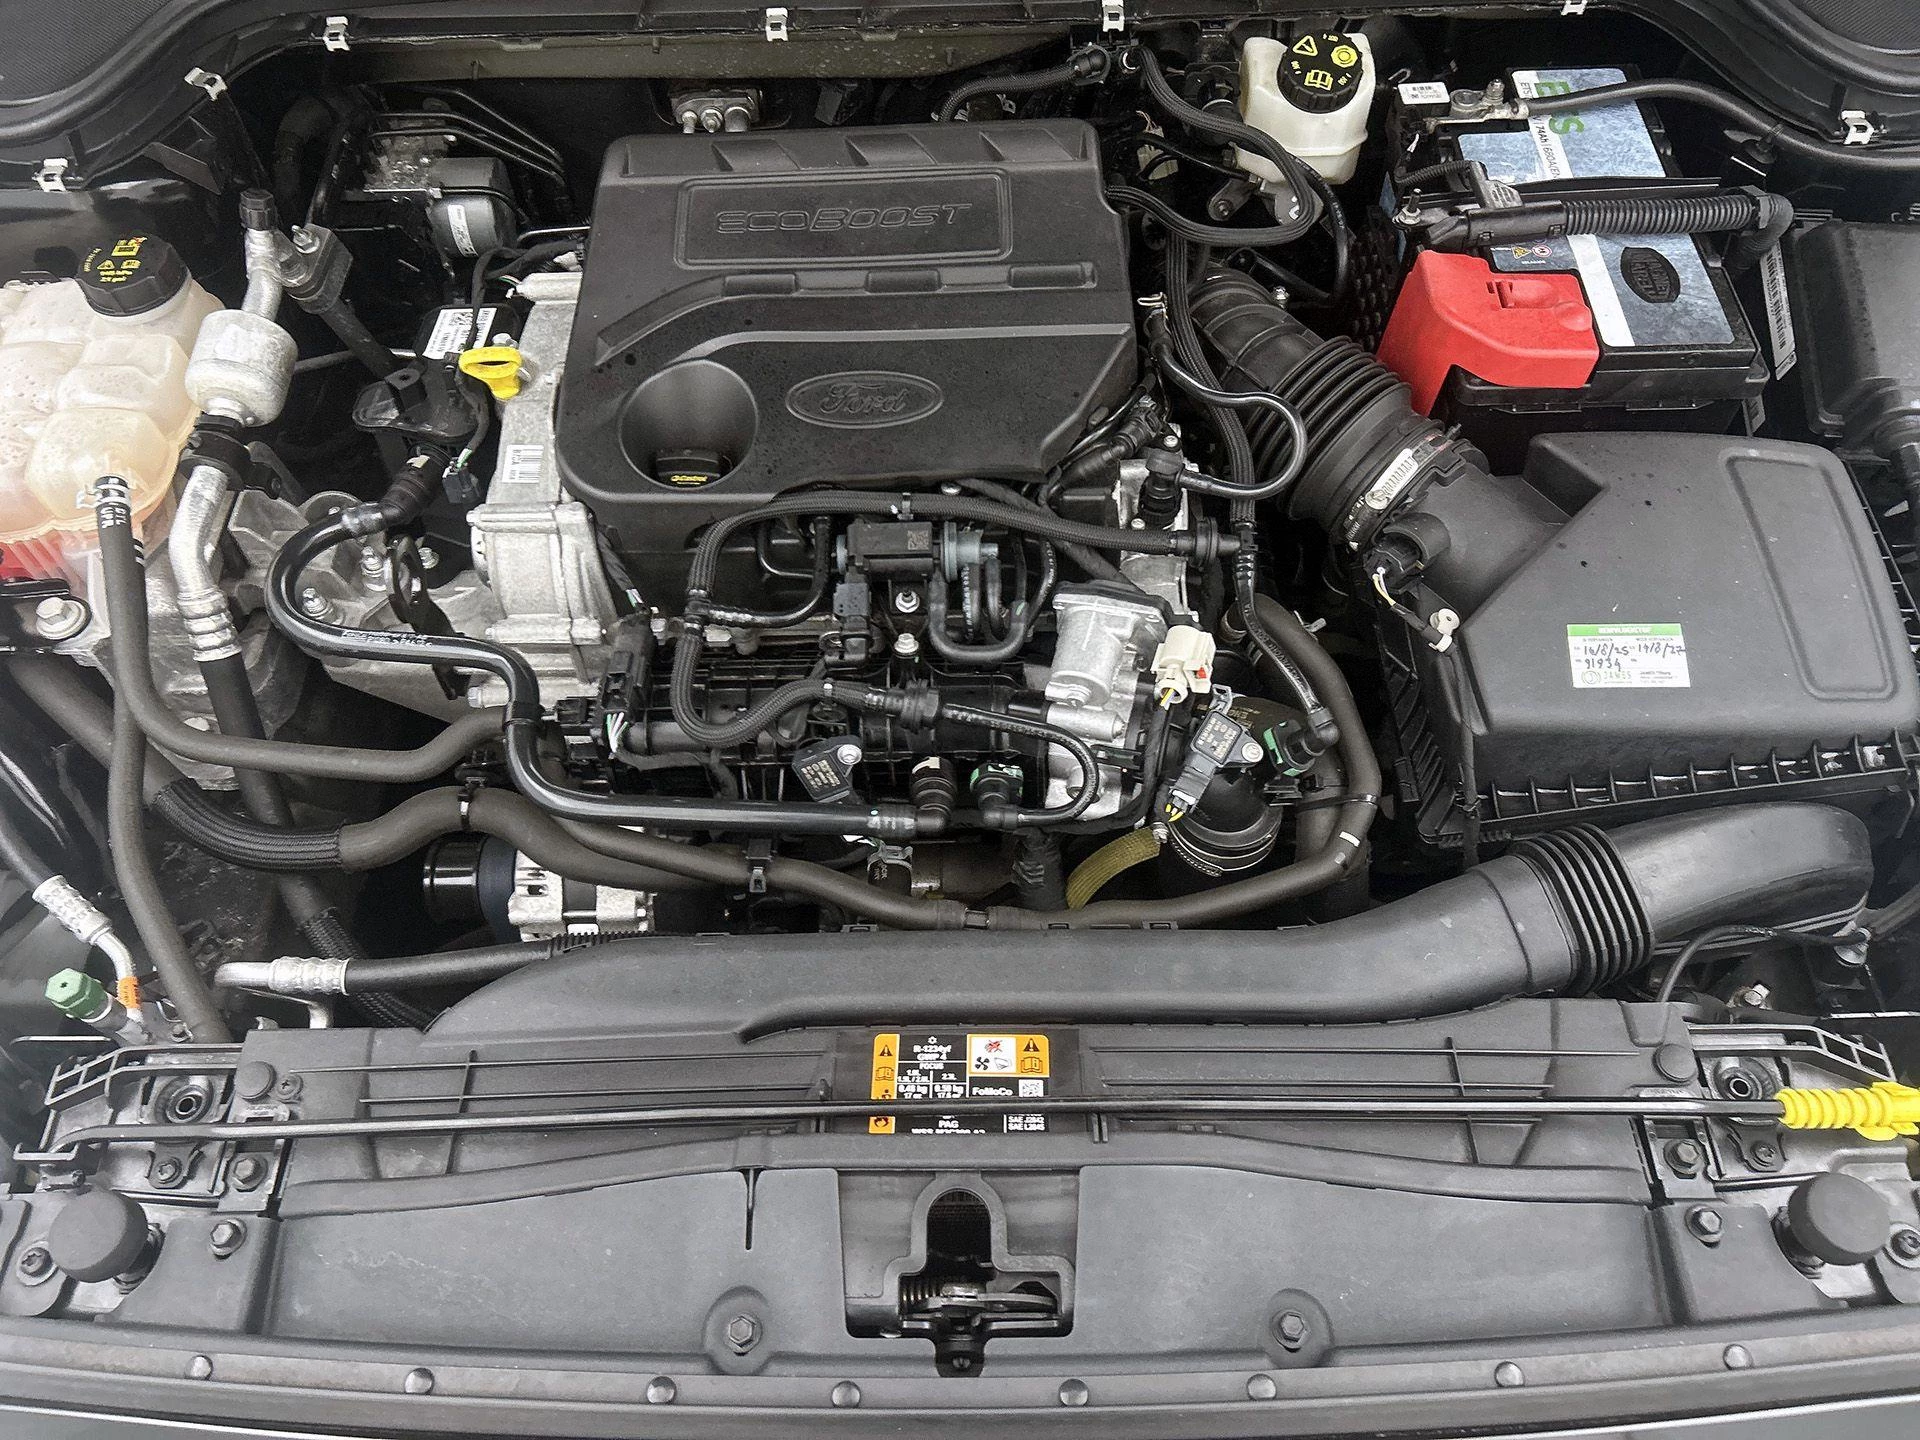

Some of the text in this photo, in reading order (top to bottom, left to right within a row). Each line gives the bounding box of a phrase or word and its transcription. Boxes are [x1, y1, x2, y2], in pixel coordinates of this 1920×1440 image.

[819, 383, 908, 414] Ford
[972, 1087, 1014, 1096] FoMoCo
[938, 1120, 959, 1128] PAG
[1008, 1122, 1023, 1130] SAE
